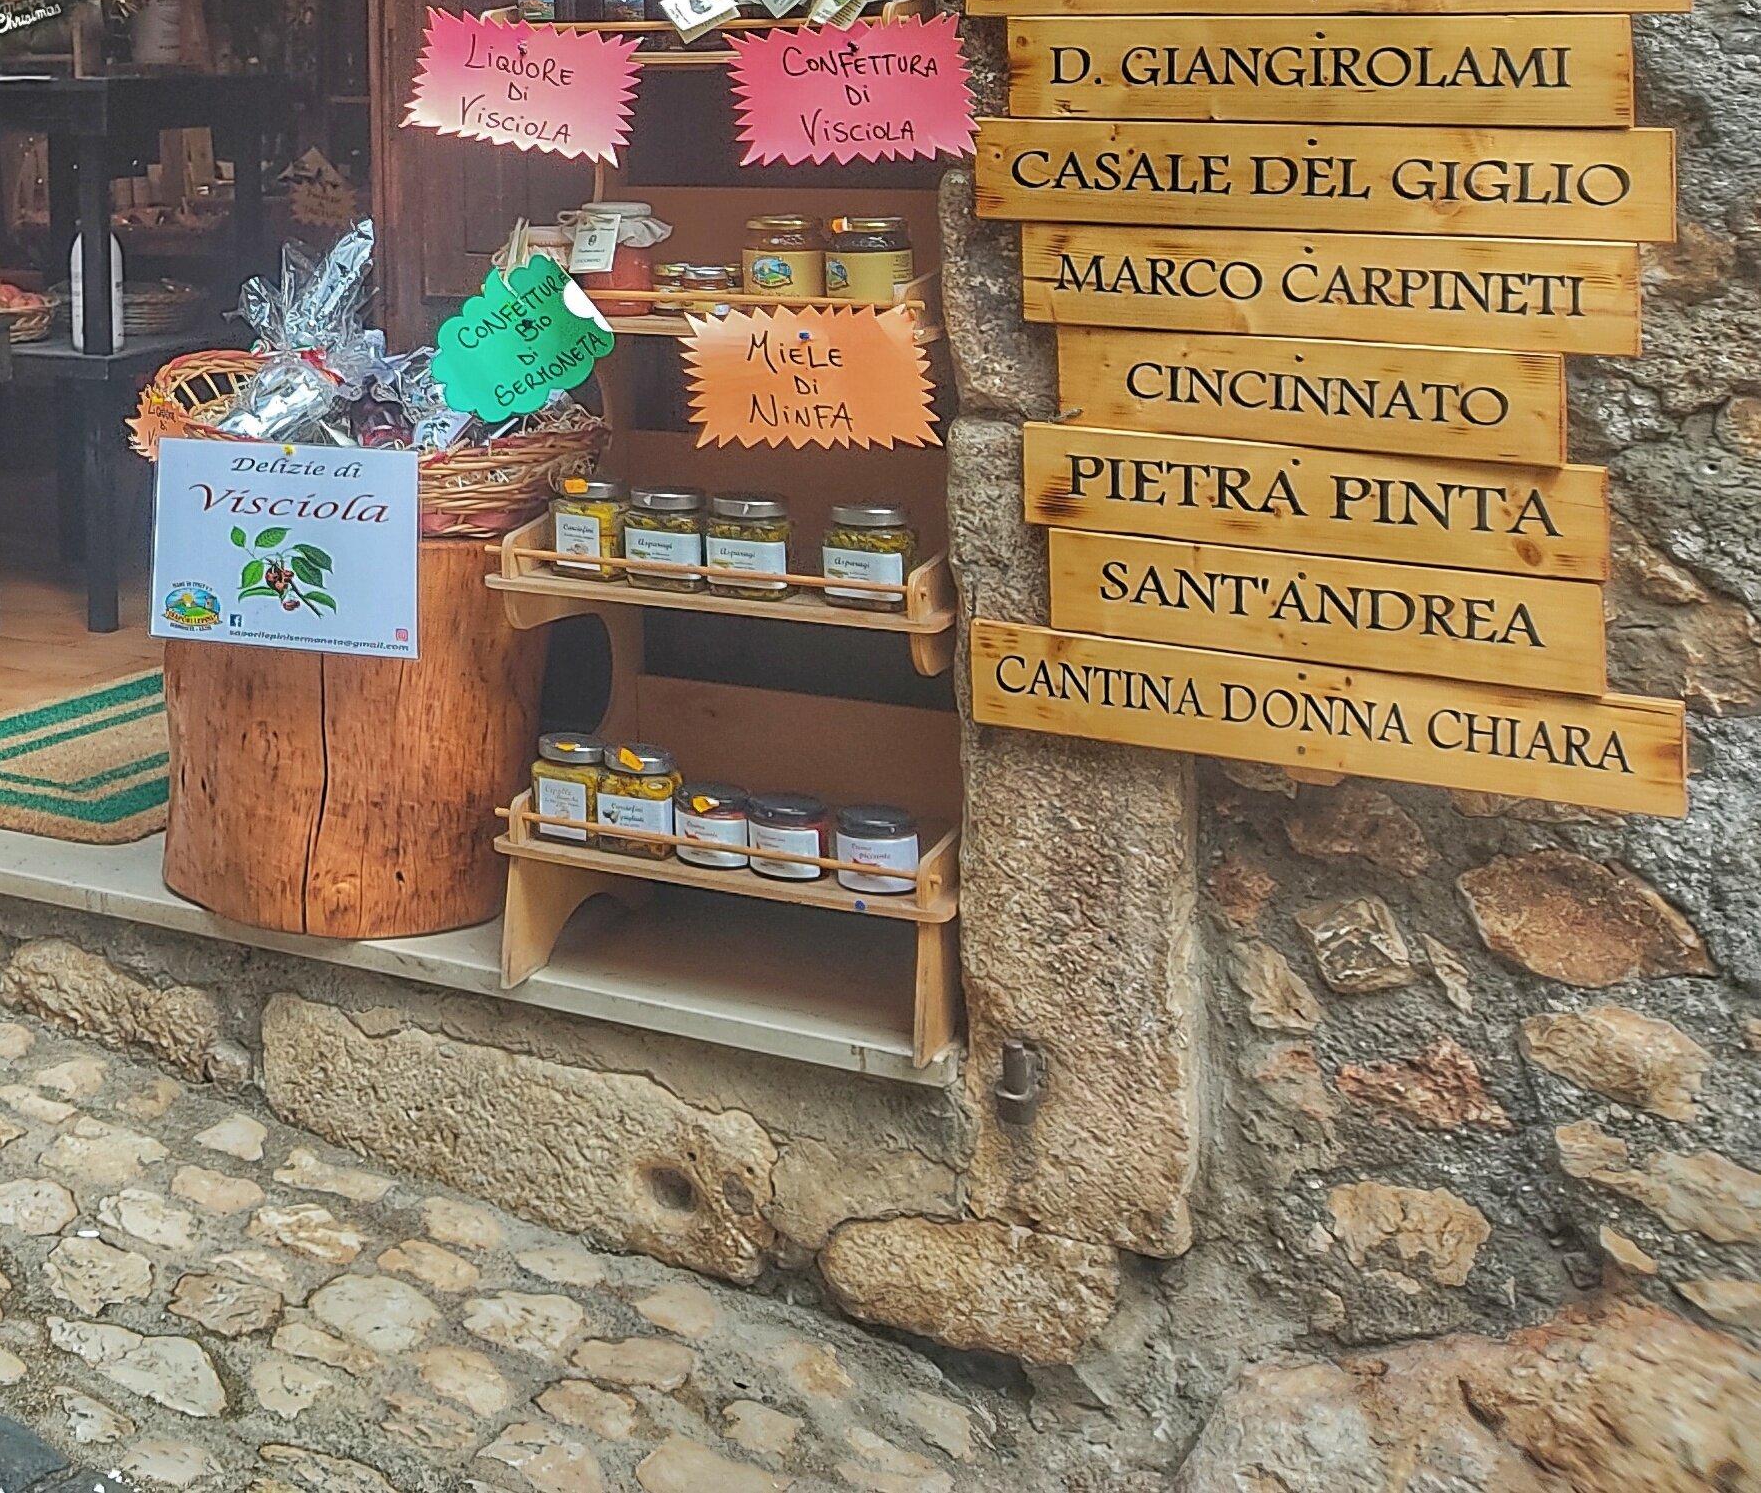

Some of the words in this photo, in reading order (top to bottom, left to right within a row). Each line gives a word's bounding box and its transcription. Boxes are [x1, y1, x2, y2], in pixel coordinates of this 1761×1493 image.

[783, 46, 939, 79] CONFETTURA
[1049, 46, 1102, 85] D.
[1121, 45, 1571, 89] GIANGIROLAMI
[1011, 150, 1232, 194] CASALE
[1250, 156, 1370, 199] DEL
[1392, 159, 1631, 207] GIGLIO
[1054, 253, 1263, 301] MARCO
[1281, 262, 1586, 317] CARPINETI
[494, 332, 608, 406] SERMONETA
[1126, 362, 1509, 426] CINCINNATO
[230, 457, 326, 476] Delizie
[334, 461, 363, 479] di
[1066, 454, 1307, 517] PIETRA
[1330, 475, 1563, 537] PINTA
[189, 483, 390, 523] Visciola
[1100, 561, 1545, 648] SANT'ANDREA
[995, 655, 1205, 719] CANTINA
[1220, 683, 1412, 744] DONNA
[1428, 710, 1634, 774] CHIARA
